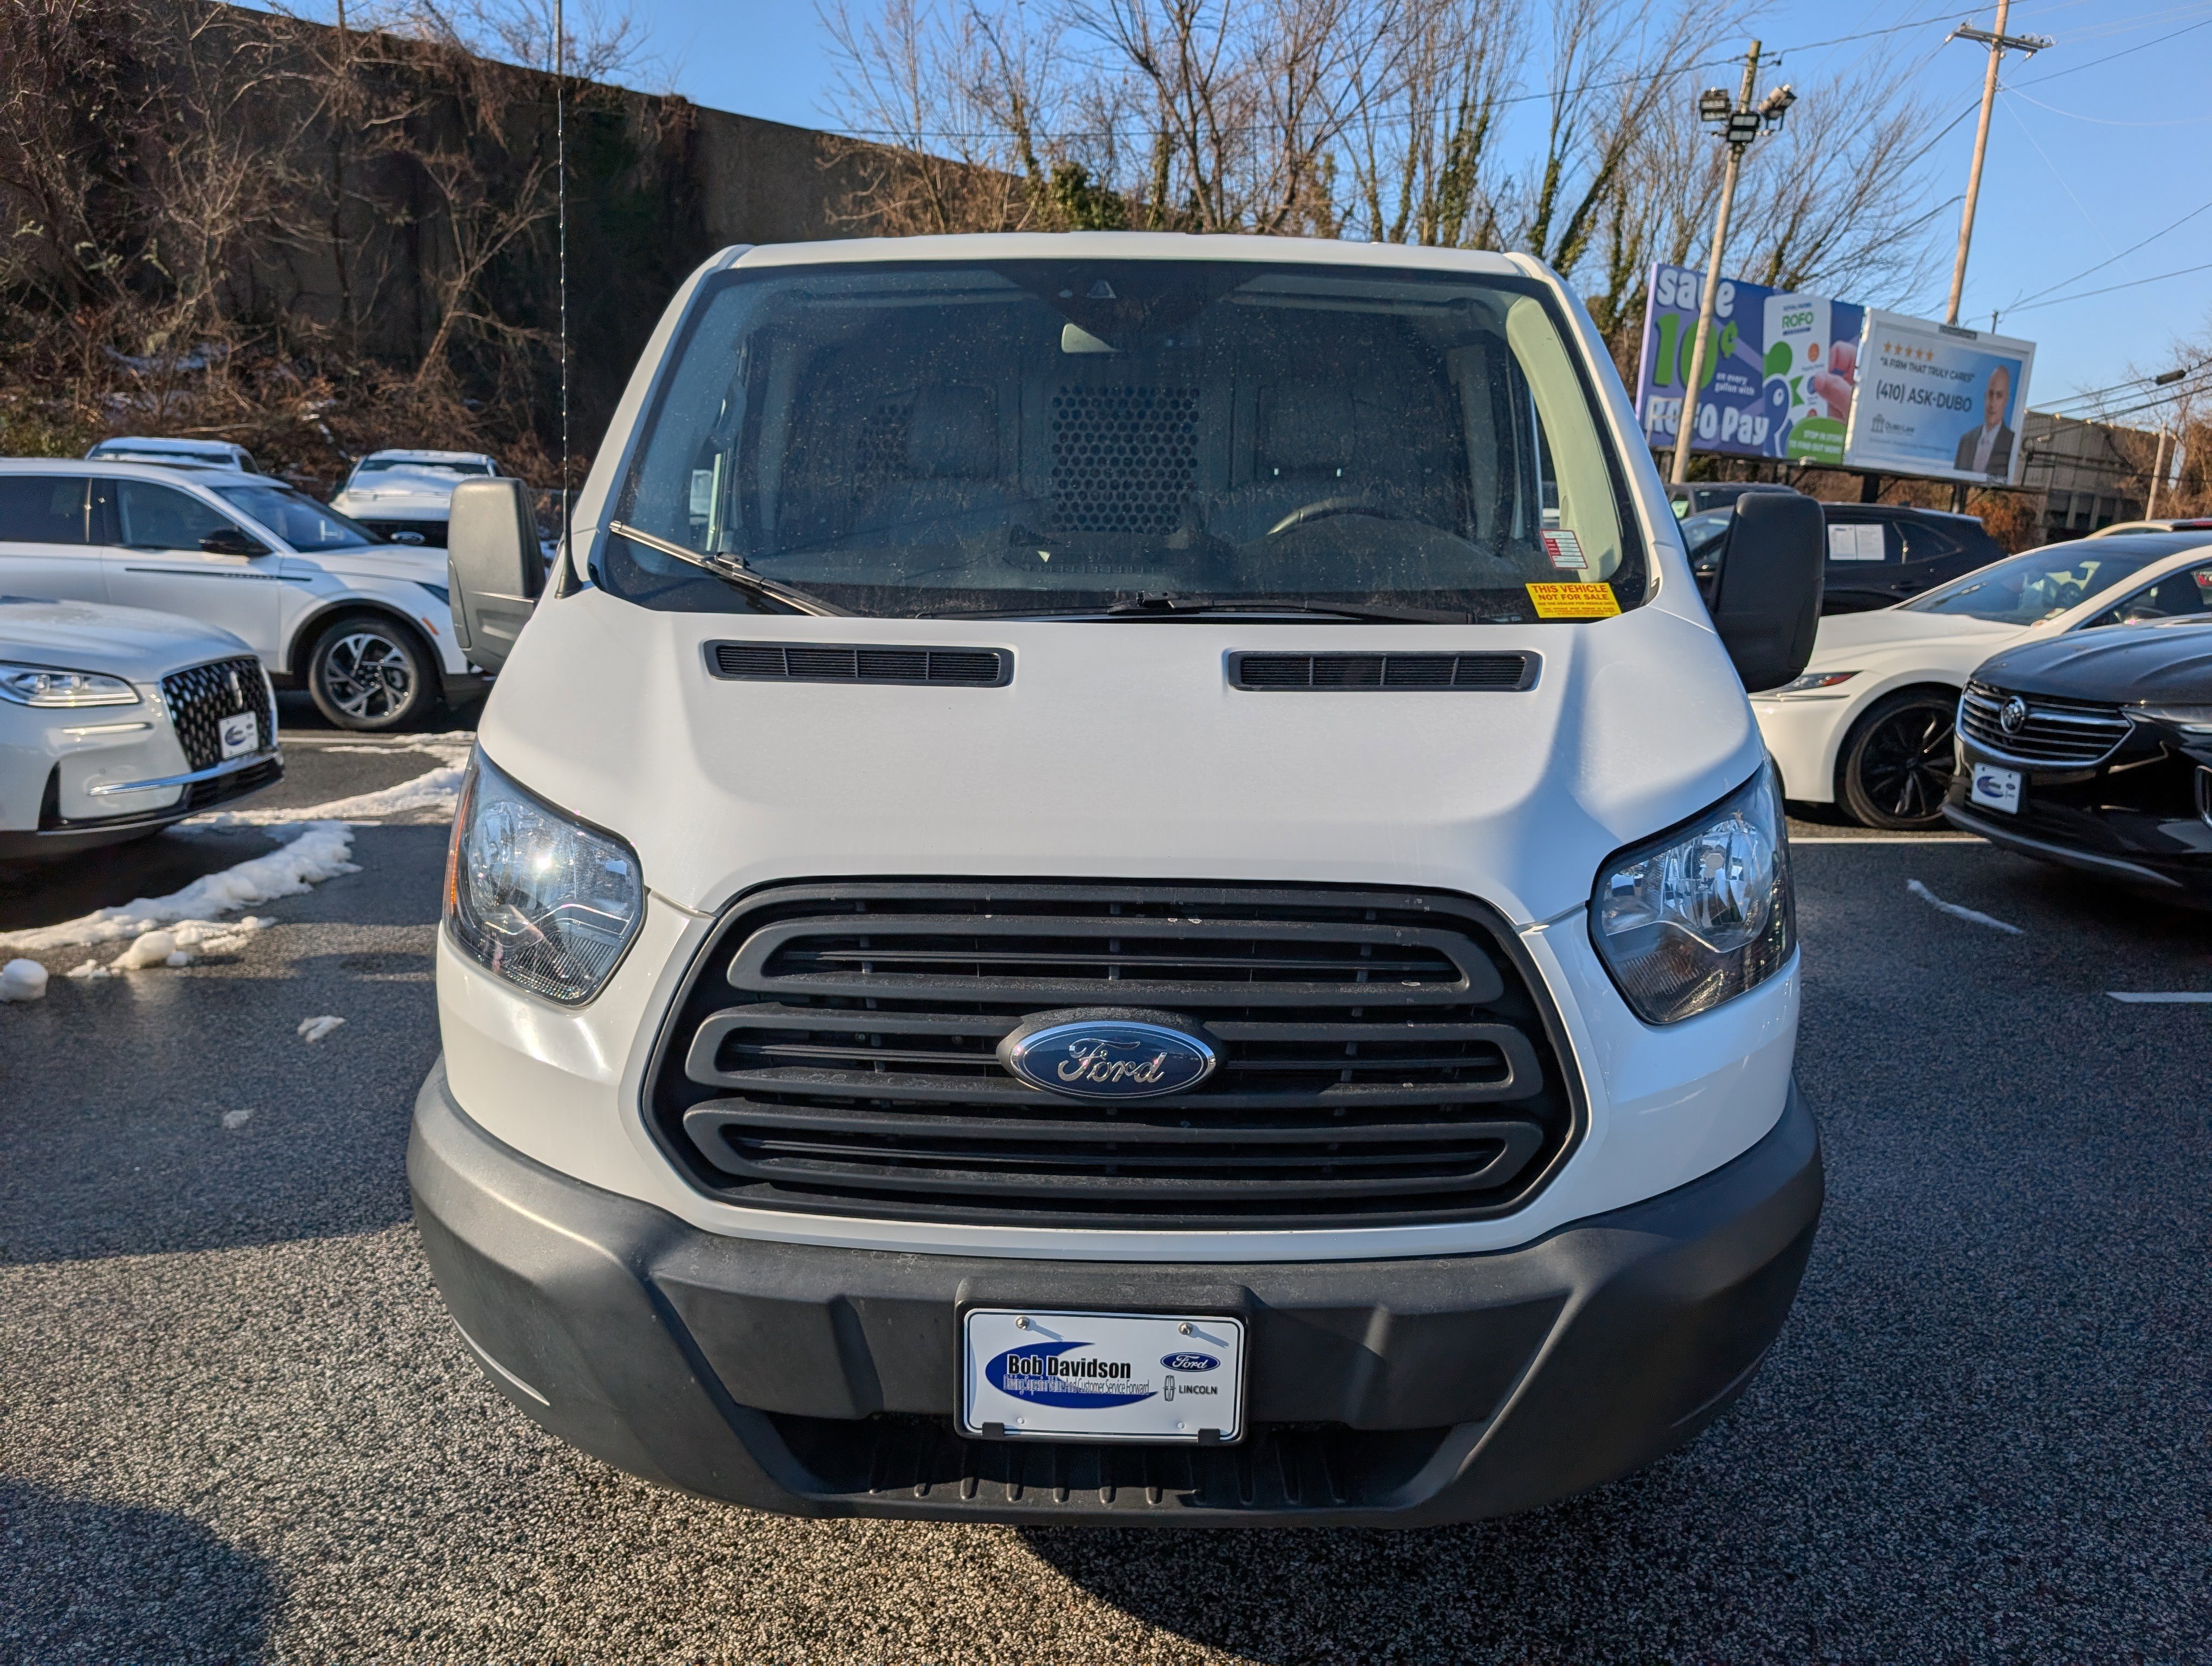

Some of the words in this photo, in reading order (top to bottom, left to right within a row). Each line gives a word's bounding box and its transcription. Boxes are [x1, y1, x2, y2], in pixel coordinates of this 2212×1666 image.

[1783, 312, 1814, 328] ROFO
[1890, 359, 1907, 369] FIRM
[1908, 362, 1926, 374] THAT
[1927, 366, 1949, 378] TRULY
[1716, 372, 1726, 380] on
[1727, 374, 1748, 386] every
[1714, 382, 1737, 393] gallon
[1738, 386, 1756, 396] with
[1876, 380, 1905, 404] (410)
[1721, 406, 1770, 446] Pay
[1531, 585, 1558, 593] THIS
[1559, 585, 1608, 593] VEHICLE
[1058, 1038, 1168, 1084] Ford
[1008, 1355, 1044, 1376] Bob
[1047, 1356, 1131, 1379] Davidson
[1172, 1355, 1209, 1369] Ford
[1066, 1377, 1077, 1393] And
[1077, 1378, 1105, 1394] Customer
[1105, 1379, 1125, 1394] Service
[1126, 1379, 1150, 1395] Forward
[1179, 1385, 1218, 1394] LINCOLN
